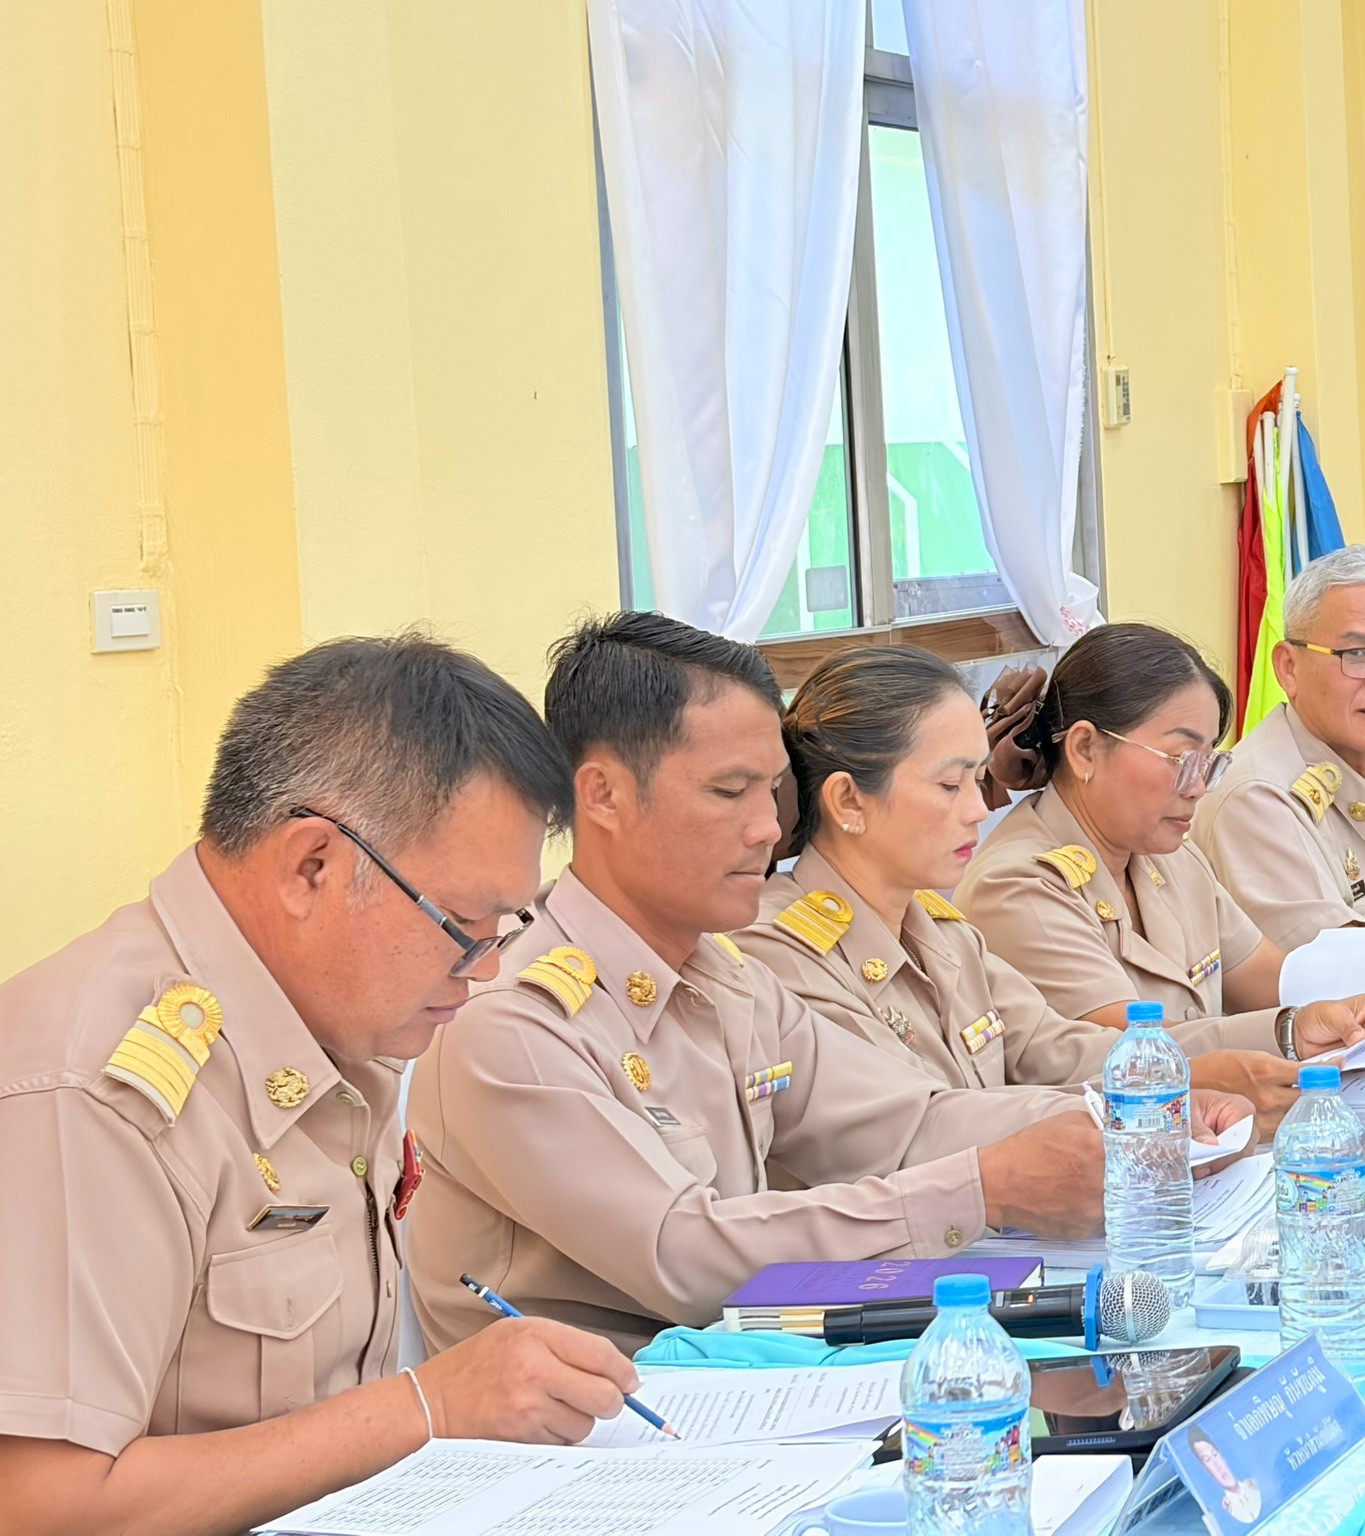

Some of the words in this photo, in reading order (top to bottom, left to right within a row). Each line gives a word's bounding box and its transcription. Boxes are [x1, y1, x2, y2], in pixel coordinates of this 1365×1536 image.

[858, 1261, 911, 1290] 2026
[1227, 1393, 1294, 1441] จ่าเอกพิษณุ
